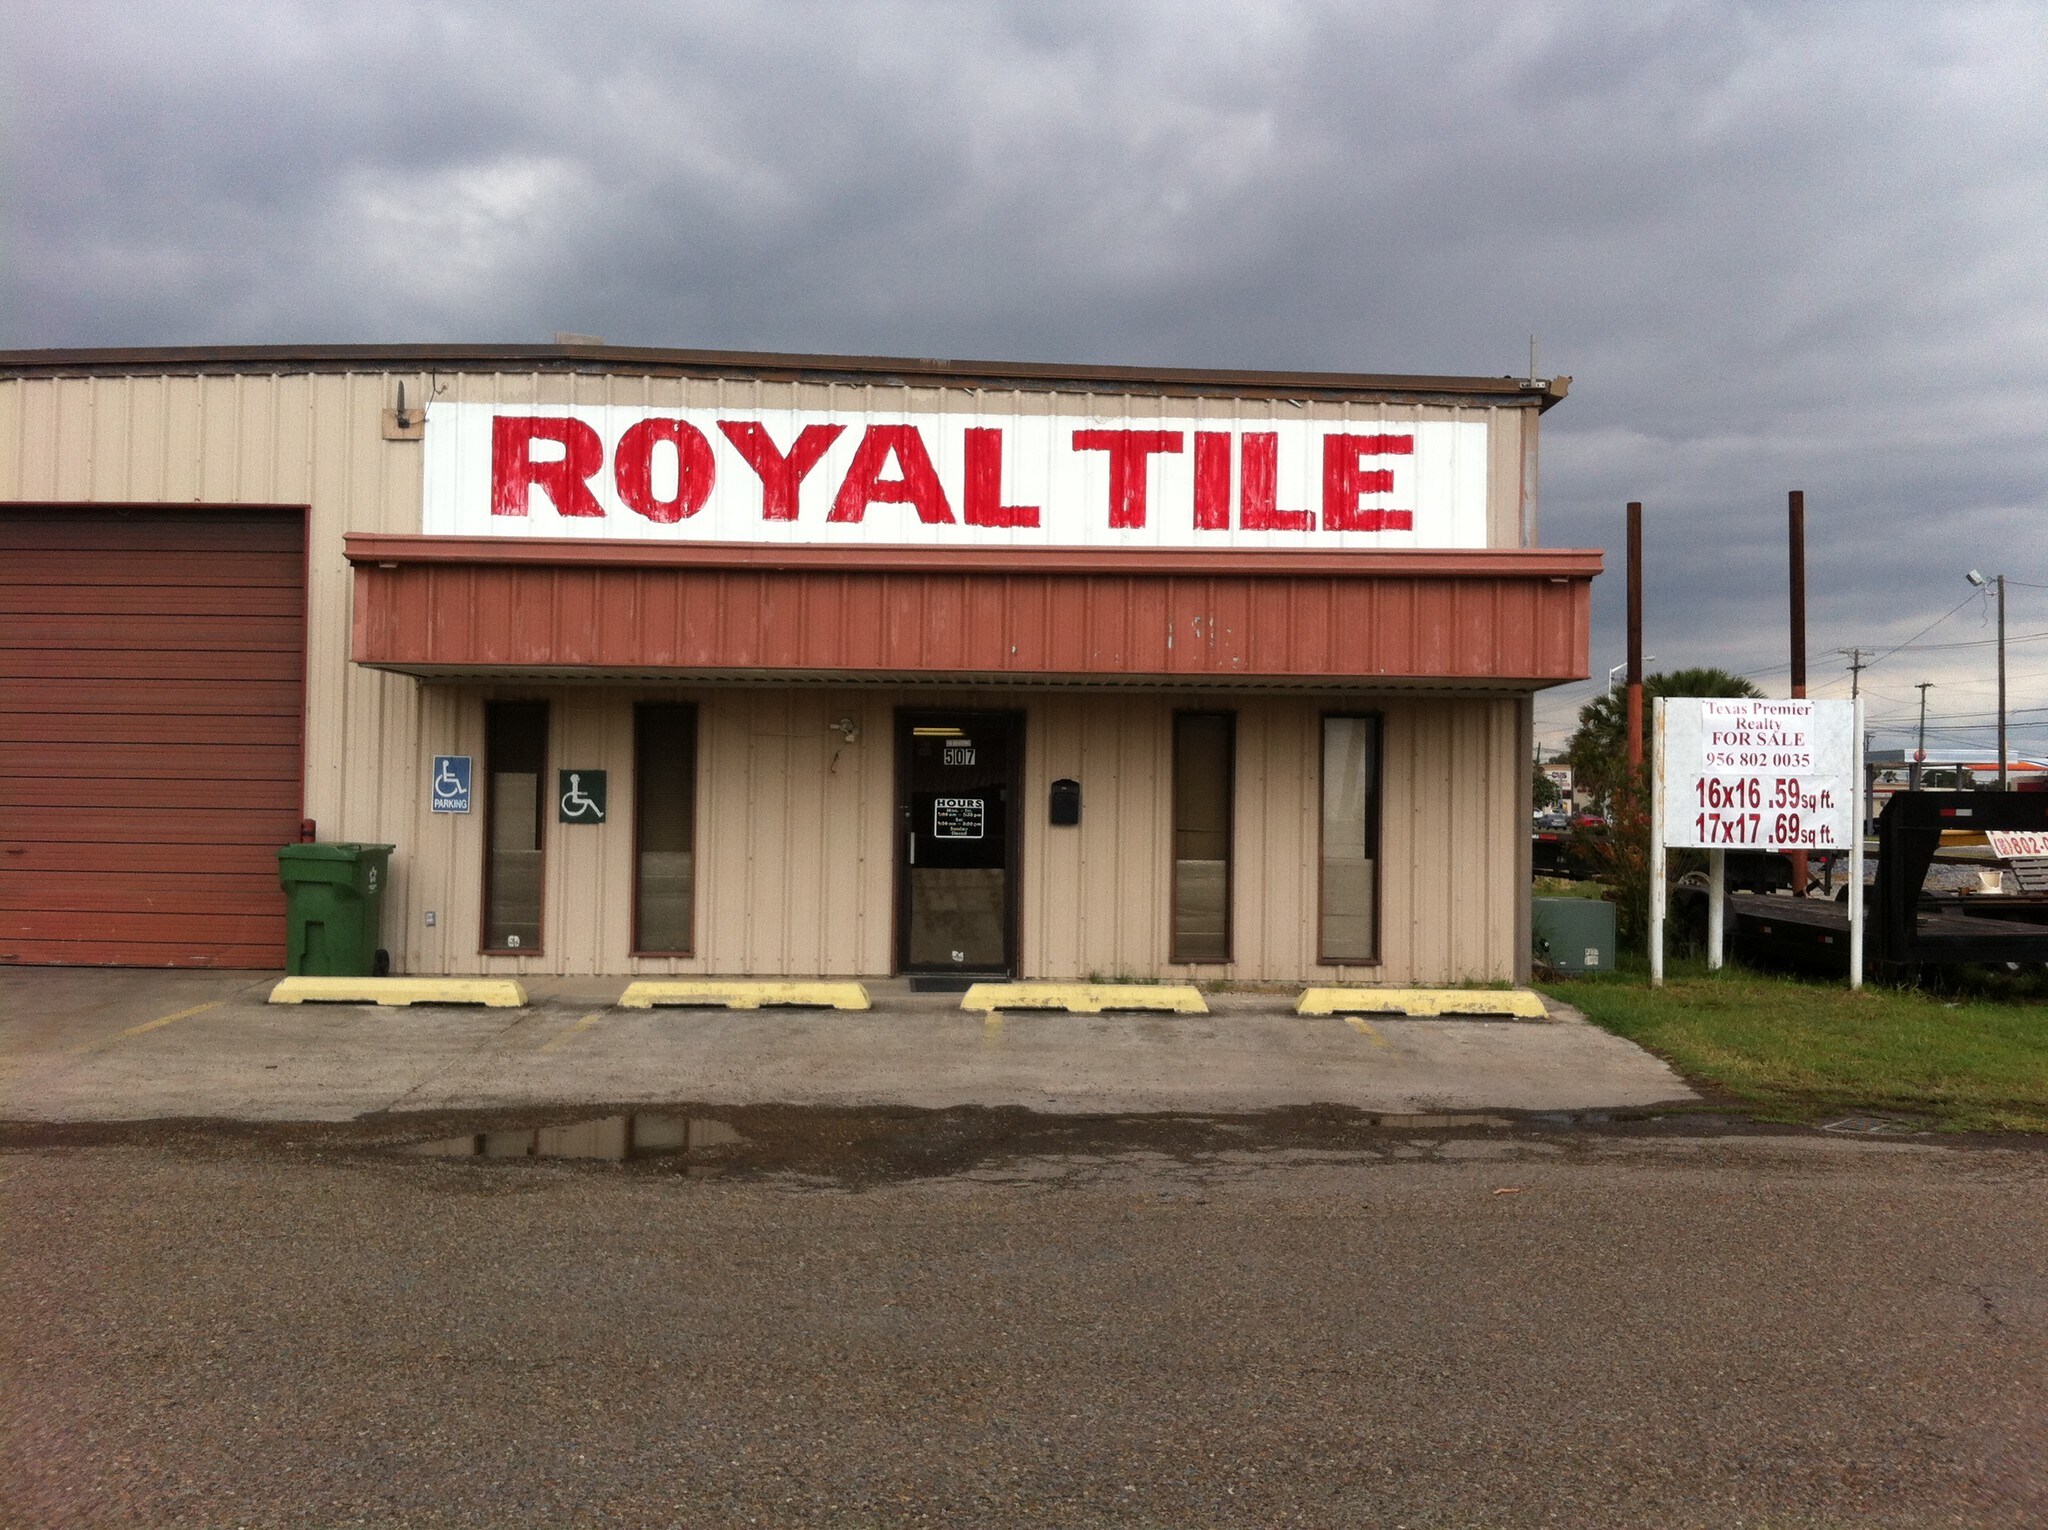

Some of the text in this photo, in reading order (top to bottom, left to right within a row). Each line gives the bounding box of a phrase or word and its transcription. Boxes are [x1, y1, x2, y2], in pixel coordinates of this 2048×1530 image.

[490, 415, 1414, 531] ROYAL TILE
[1706, 702, 1812, 716] Texas Premier
[1735, 718, 1783, 733] Realty
[1712, 732, 1805, 747] FOR SALE
[945, 749, 975, 764] 507
[1706, 752, 1810, 768] 956 802 0035
[1695, 777, 1761, 809] 16x16
[434, 798, 467, 809] PARKING
[937, 799, 982, 807] HOURS
[1695, 812, 1761, 843] 17x17
